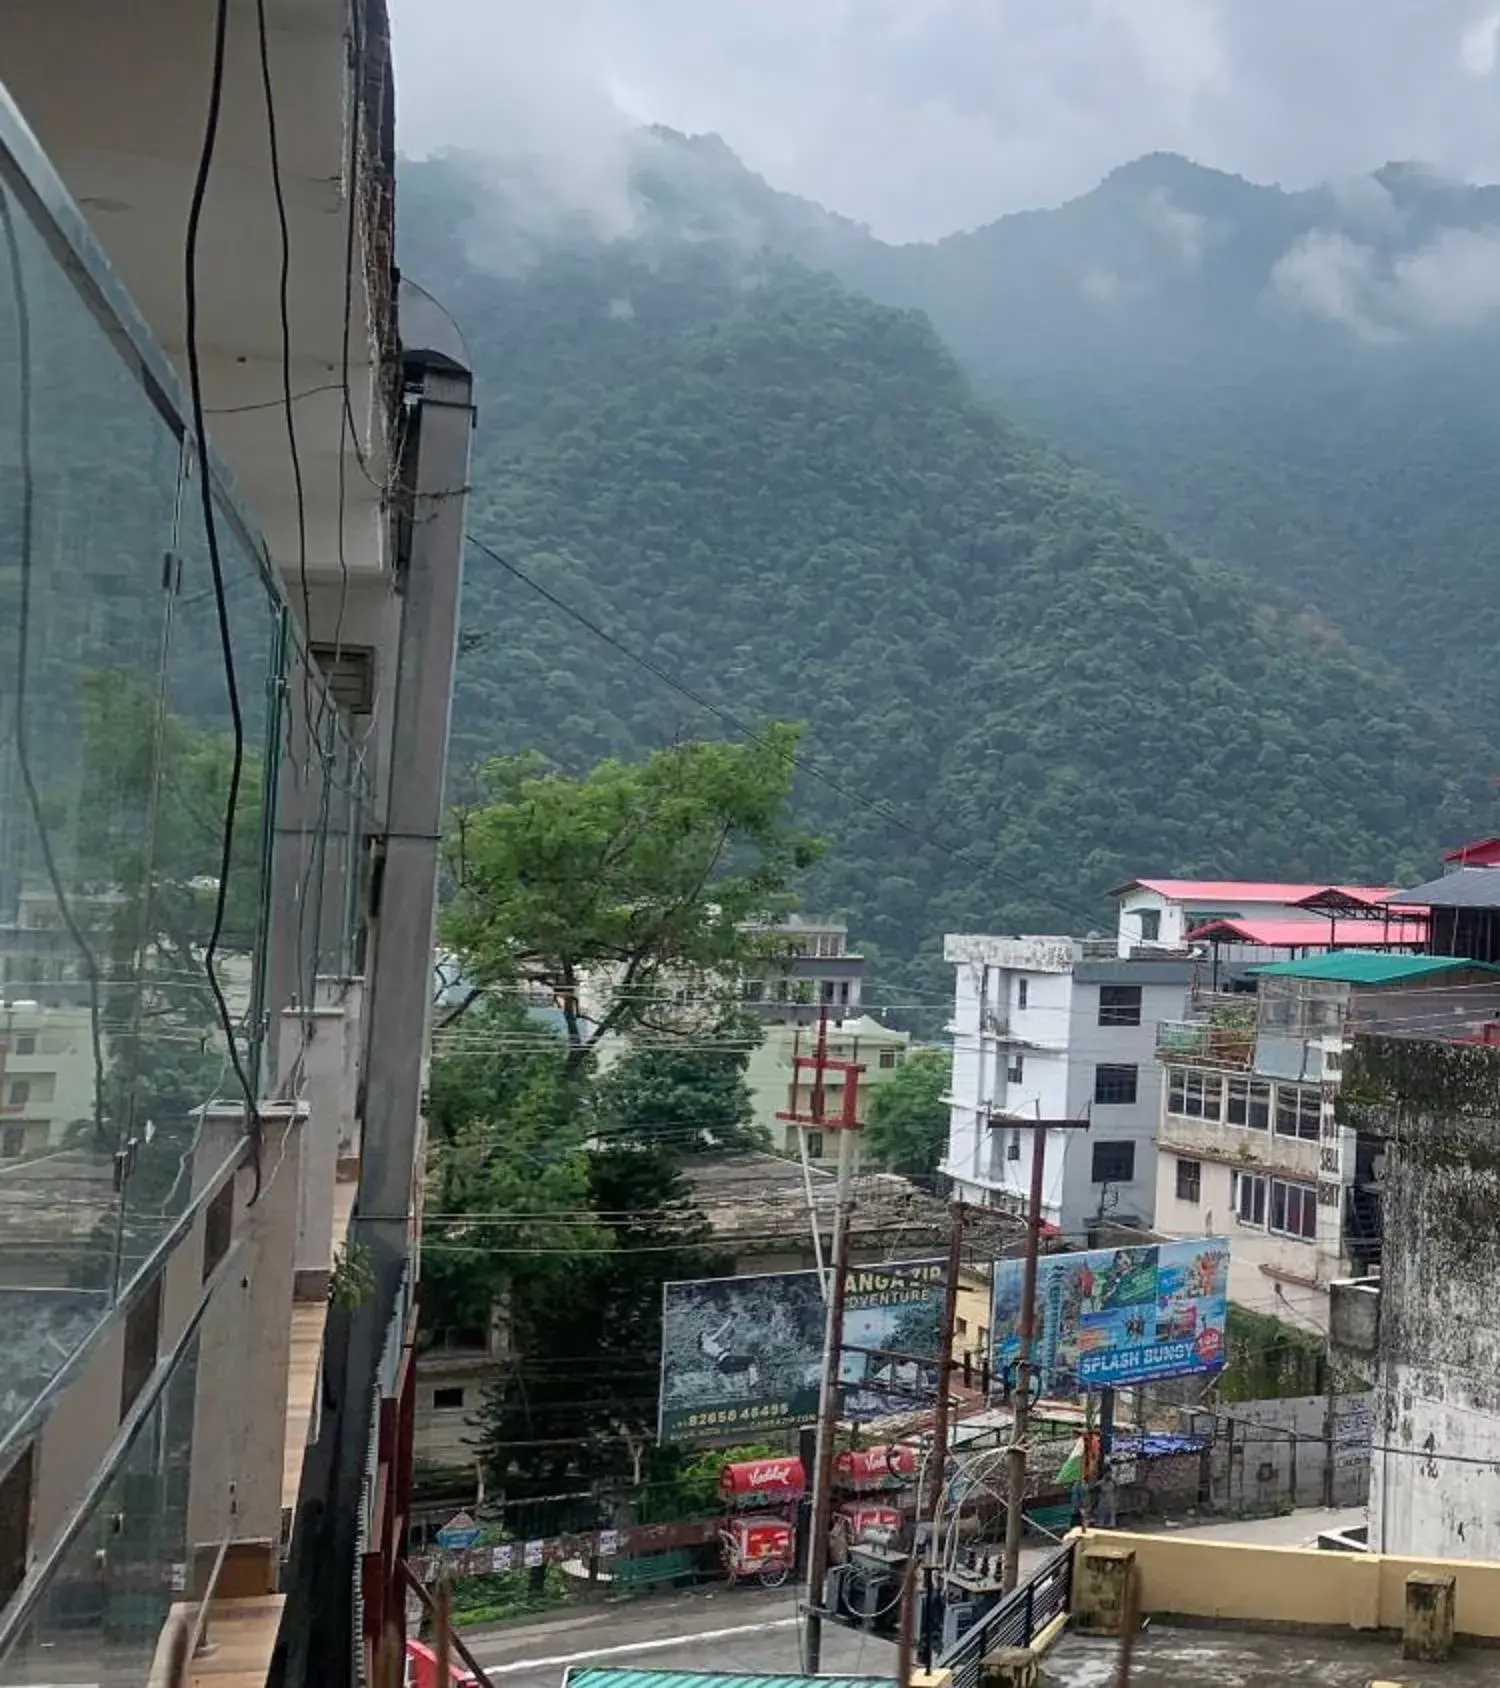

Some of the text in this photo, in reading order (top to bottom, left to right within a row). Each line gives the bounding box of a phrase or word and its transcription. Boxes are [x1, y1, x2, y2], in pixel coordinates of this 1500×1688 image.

[843, 1273, 905, 1293] ANGA
[843, 1289, 930, 1309] DVENTURE
[1081, 1351, 1140, 1375] SPLASH
[1143, 1343, 1194, 1366] BUNGY
